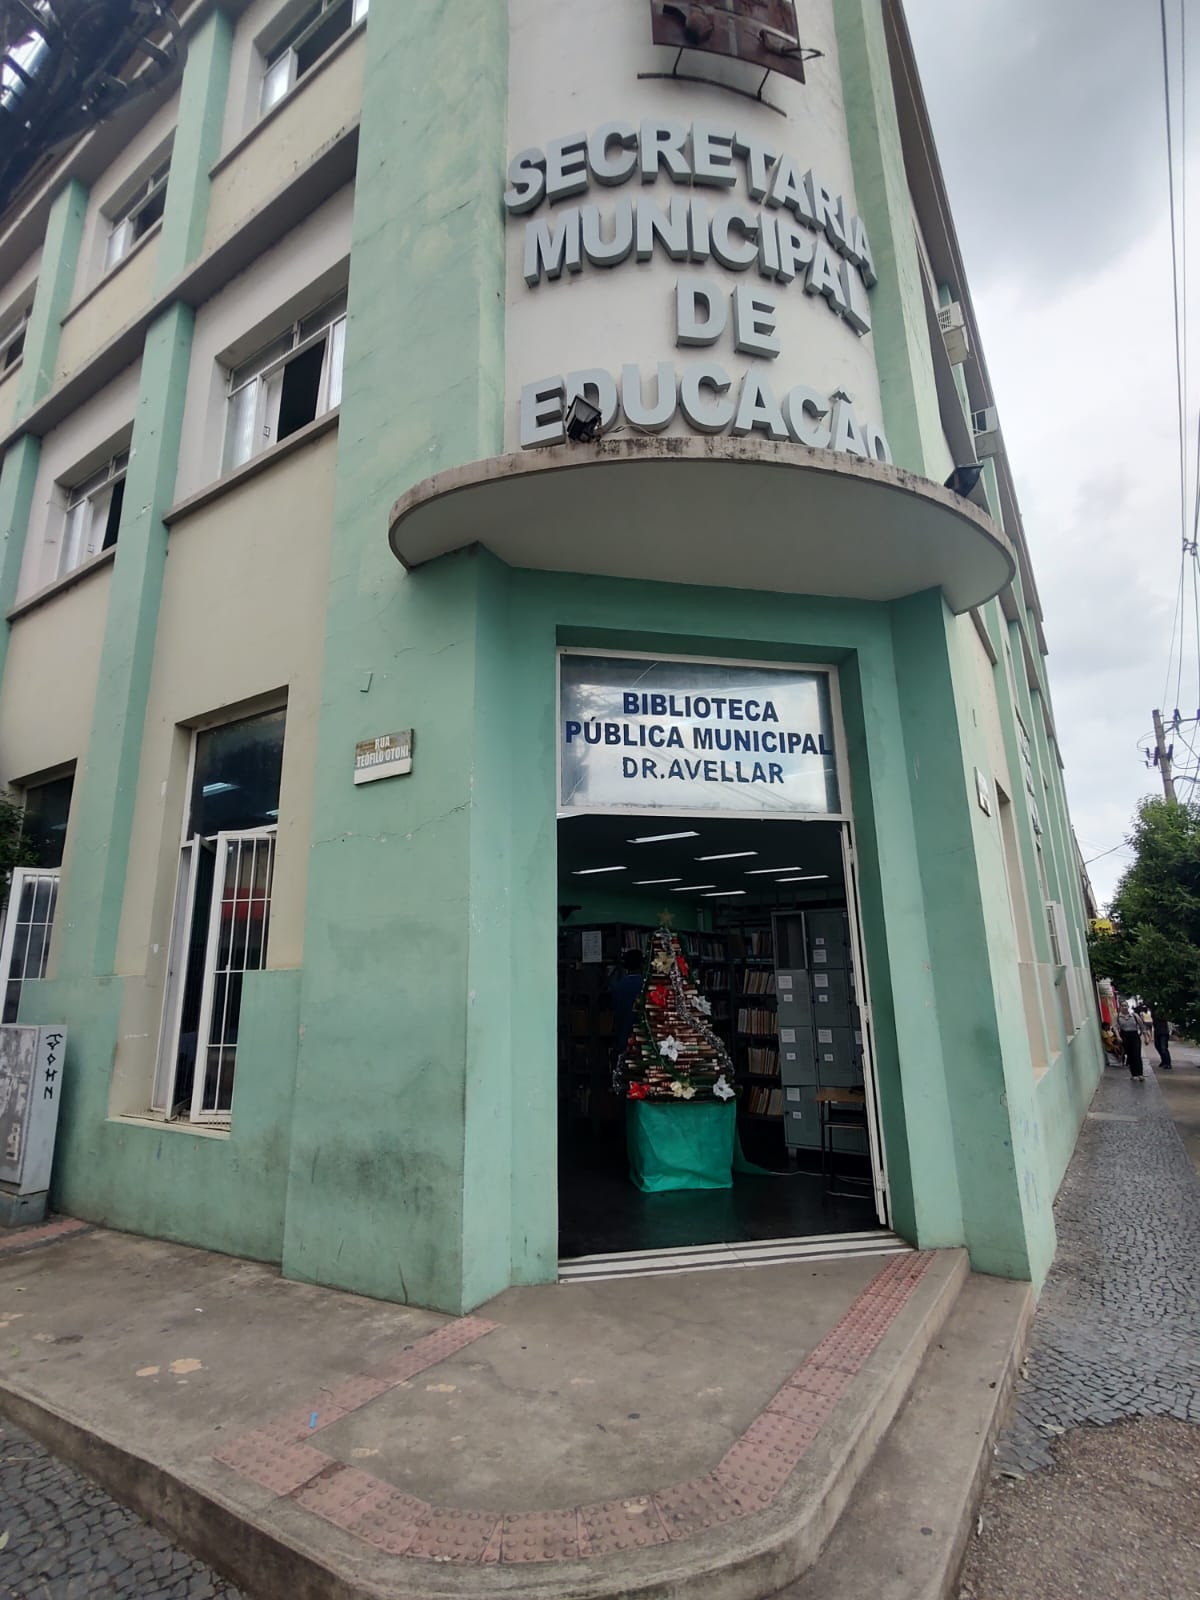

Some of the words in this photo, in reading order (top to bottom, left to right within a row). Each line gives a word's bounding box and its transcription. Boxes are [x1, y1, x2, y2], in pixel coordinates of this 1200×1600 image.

[504, 119, 877, 288] SECRETARIA
[523, 196, 871, 337] MUNICIPAL
[676, 276, 780, 359] DE
[622, 691, 779, 723] BIBLIOTECA
[375, 736, 390, 749] RUA
[385, 745, 408, 760] OTONI
[565, 716, 685, 749] PÚBLICA
[693, 727, 834, 756] MUNICIPAL
[622, 756, 785, 784] DR.AVELLAR
